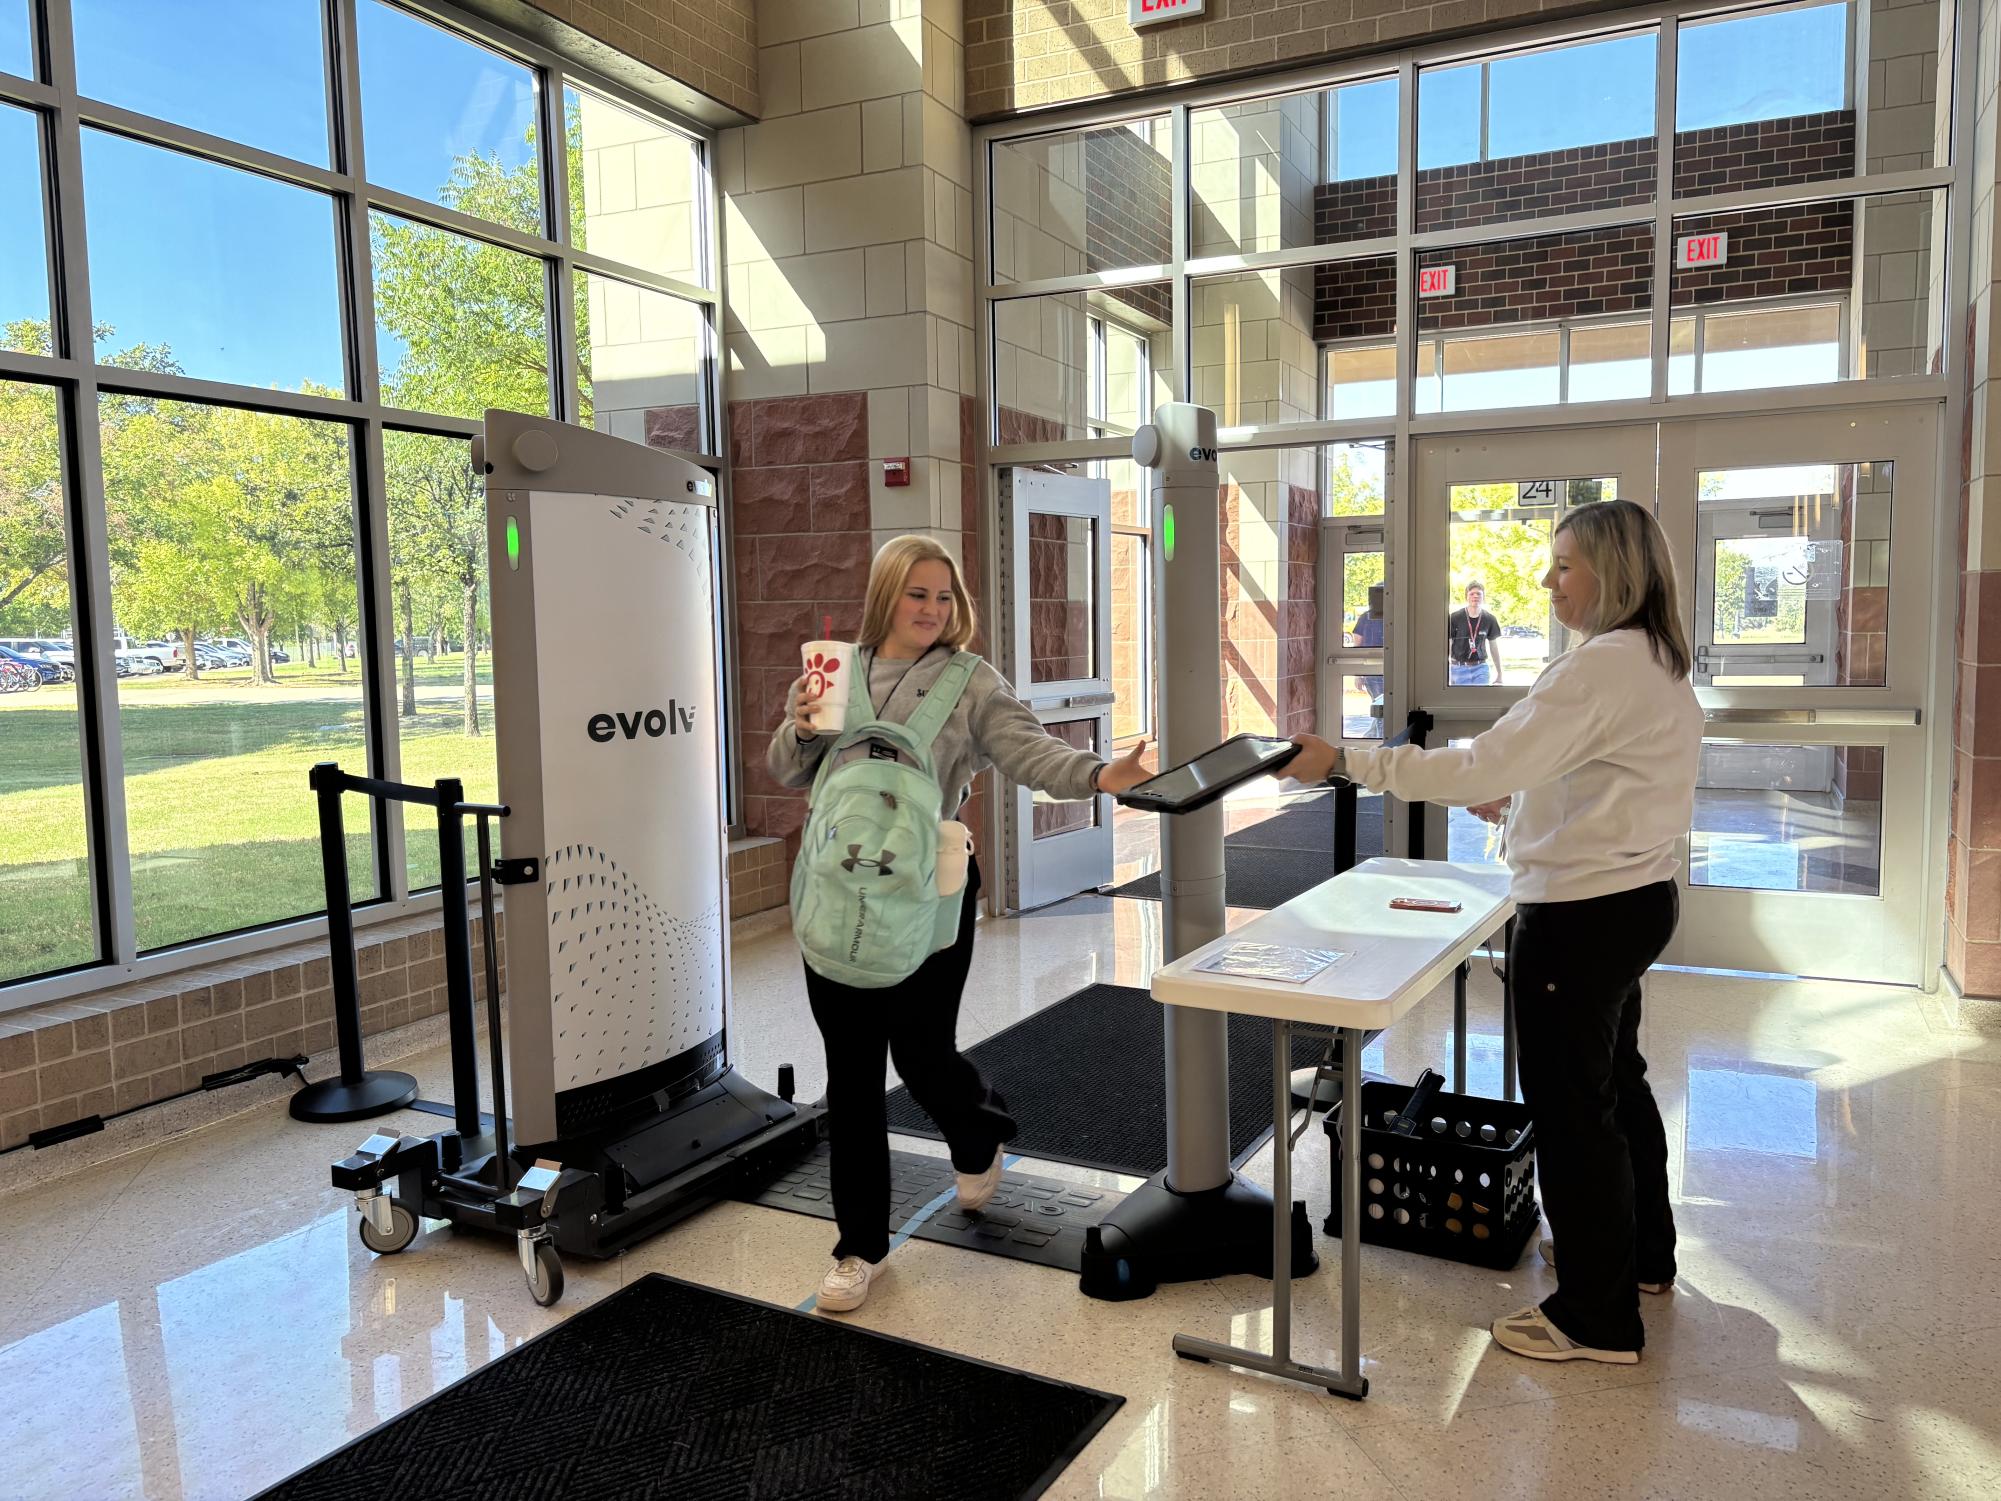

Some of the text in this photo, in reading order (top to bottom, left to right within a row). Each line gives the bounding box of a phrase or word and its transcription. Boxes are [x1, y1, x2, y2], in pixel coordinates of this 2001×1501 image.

[1687, 236, 1720, 262] EXIT
[1420, 269, 1449, 292] EXIT
[1522, 480, 1552, 499] 24
[587, 699, 696, 743] evolv
